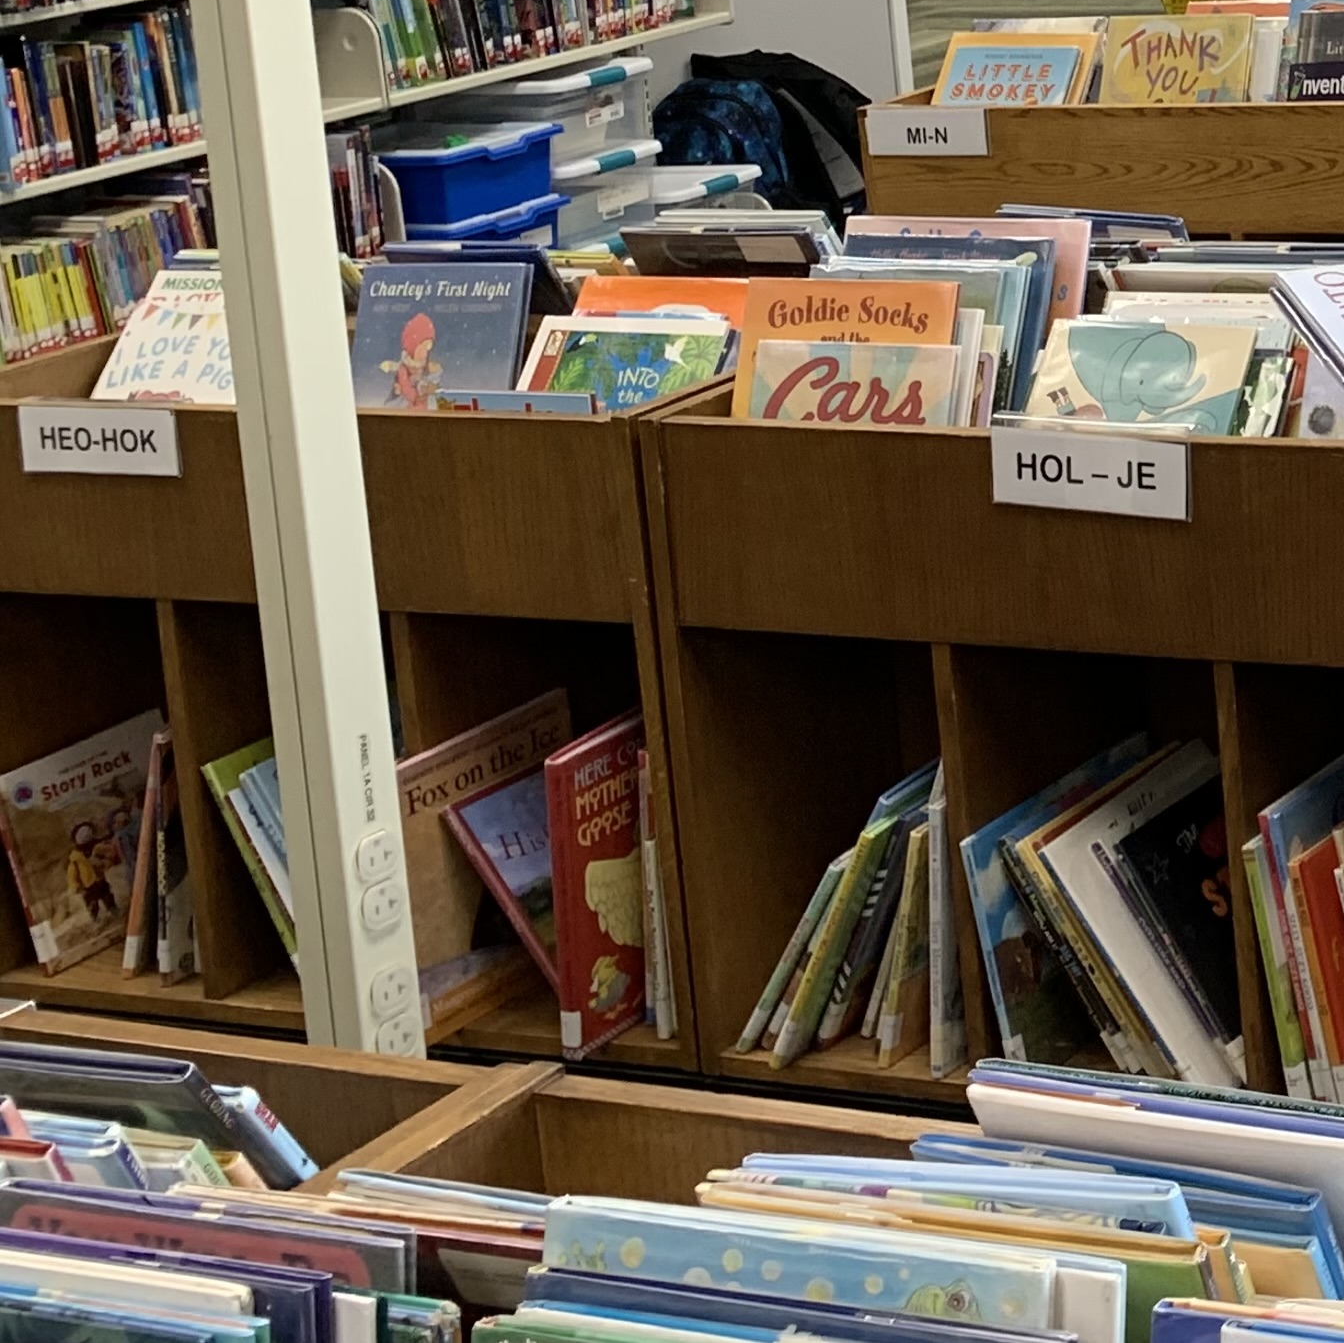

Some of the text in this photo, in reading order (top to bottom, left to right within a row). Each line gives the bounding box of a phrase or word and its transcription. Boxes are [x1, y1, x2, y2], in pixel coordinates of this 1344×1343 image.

[1121, 28, 1220, 73] THANK
[964, 64, 1053, 82] LITTLE
[950, 83, 1056, 102] SMOKEY
[906, 127, 948, 145] MI-N
[370, 279, 512, 301] Charley's First Night
[768, 294, 930, 334] Goldie Socks
[115, 347, 123, 366] I
[137, 335, 200, 359] LOVE
[106, 360, 234, 391] LIKE A PIG
[617, 368, 660, 388] INTO
[763, 356, 927, 425] Cars
[618, 389, 644, 404] the
[40, 425, 157, 456] HEO-HOK
[1016, 454, 1083, 489] HOL
[1116, 458, 1158, 491] JE
[41, 769, 86, 802] Story
[91, 749, 132, 779] Rock
[405, 779, 450, 818] Fox
[454, 766, 486, 792] on
[491, 744, 527, 775] the
[530, 723, 560, 756] Ice
[574, 754, 613, 791] HERE
[577, 801, 632, 847] GOOSE
[496, 831, 547, 861] His
